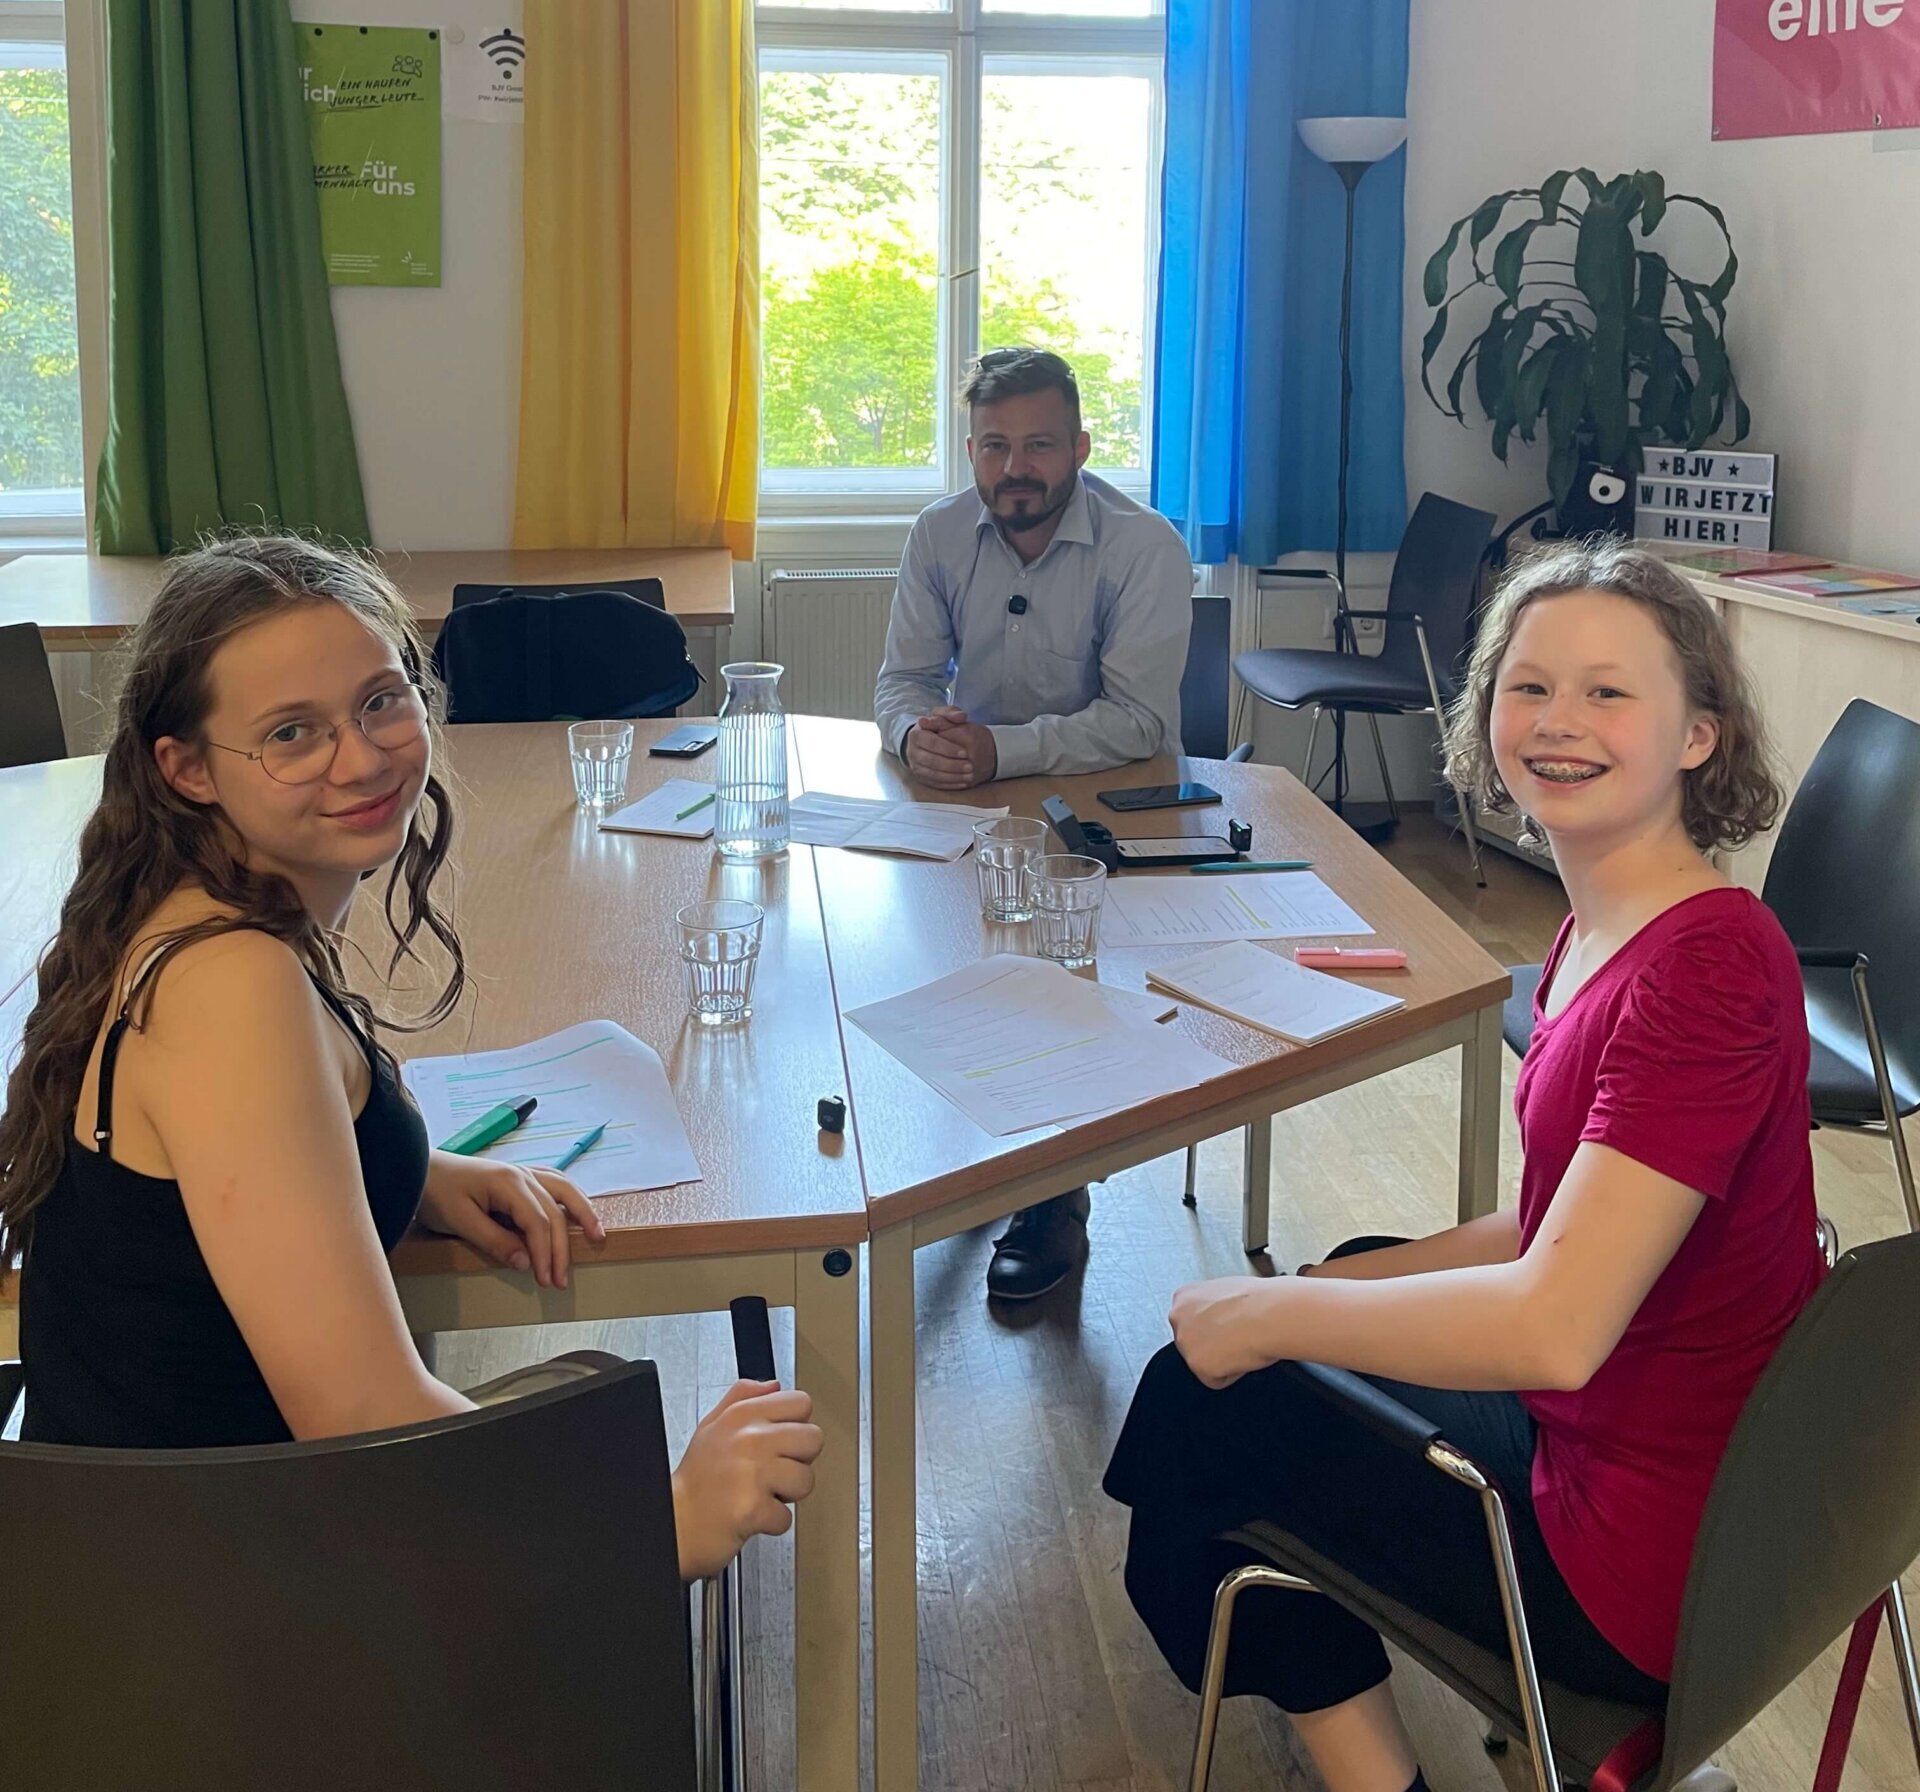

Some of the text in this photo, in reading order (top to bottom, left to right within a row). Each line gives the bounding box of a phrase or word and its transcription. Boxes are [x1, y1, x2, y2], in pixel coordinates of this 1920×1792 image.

[340, 78, 412, 91] EIN HAUFEN
[330, 93, 379, 108] JUNGER
[313, 165, 352, 175] RKER
[360, 160, 398, 179] Für
[373, 180, 416, 196] uns
[1673, 456, 1714, 477] BJV
[1664, 517, 1739, 543] HIER!
